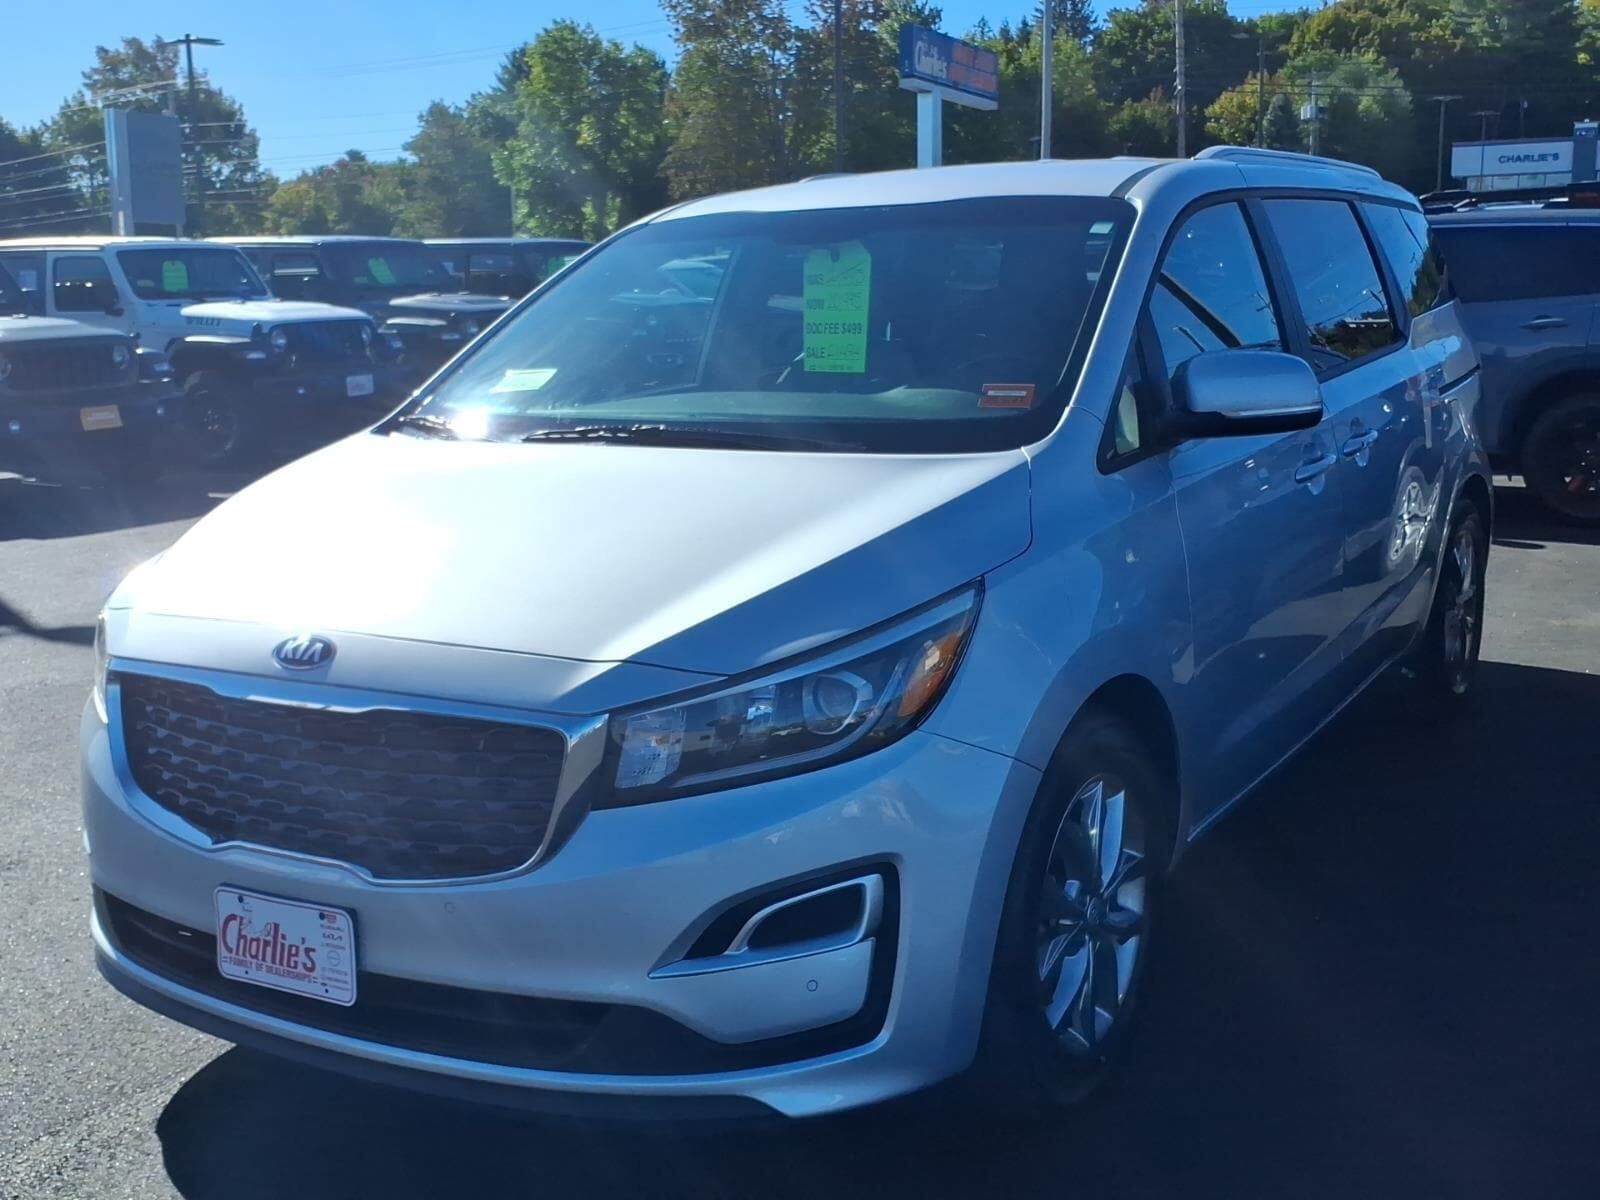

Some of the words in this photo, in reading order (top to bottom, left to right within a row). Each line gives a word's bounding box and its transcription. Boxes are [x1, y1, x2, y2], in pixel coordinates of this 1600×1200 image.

[1498, 152, 1560, 164] CHARLIE'S
[806, 322, 823, 335] DOC
[824, 322, 840, 335] FEE
[841, 322, 863, 335] $499
[806, 346, 825, 359] SALE
[279, 639, 324, 662] KIA
[221, 913, 317, 973] Charlie's
[229, 956, 255, 970] FAMILY
[255, 961, 265, 971] OF
